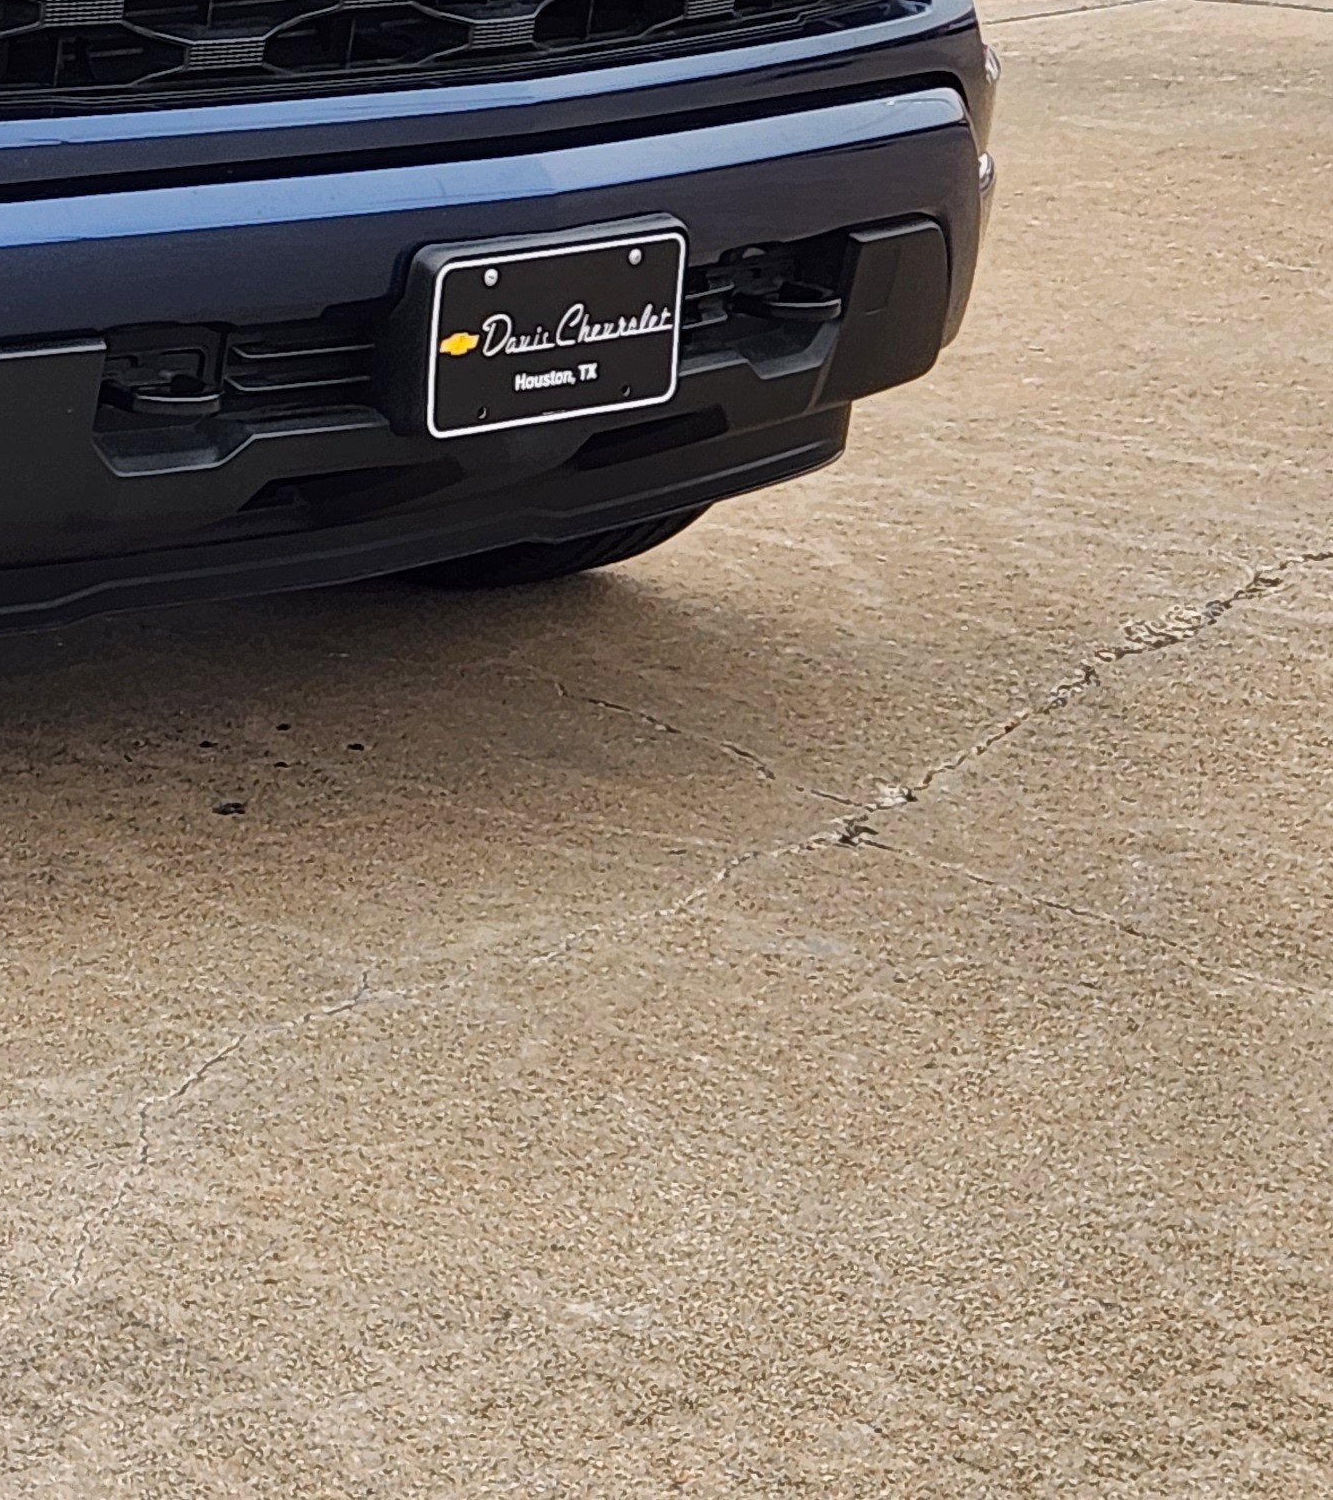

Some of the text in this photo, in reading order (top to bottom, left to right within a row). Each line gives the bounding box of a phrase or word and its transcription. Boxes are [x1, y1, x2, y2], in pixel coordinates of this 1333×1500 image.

[482, 303, 674, 357] Davis Chevrolet
[514, 362, 599, 392] Houston, TX
